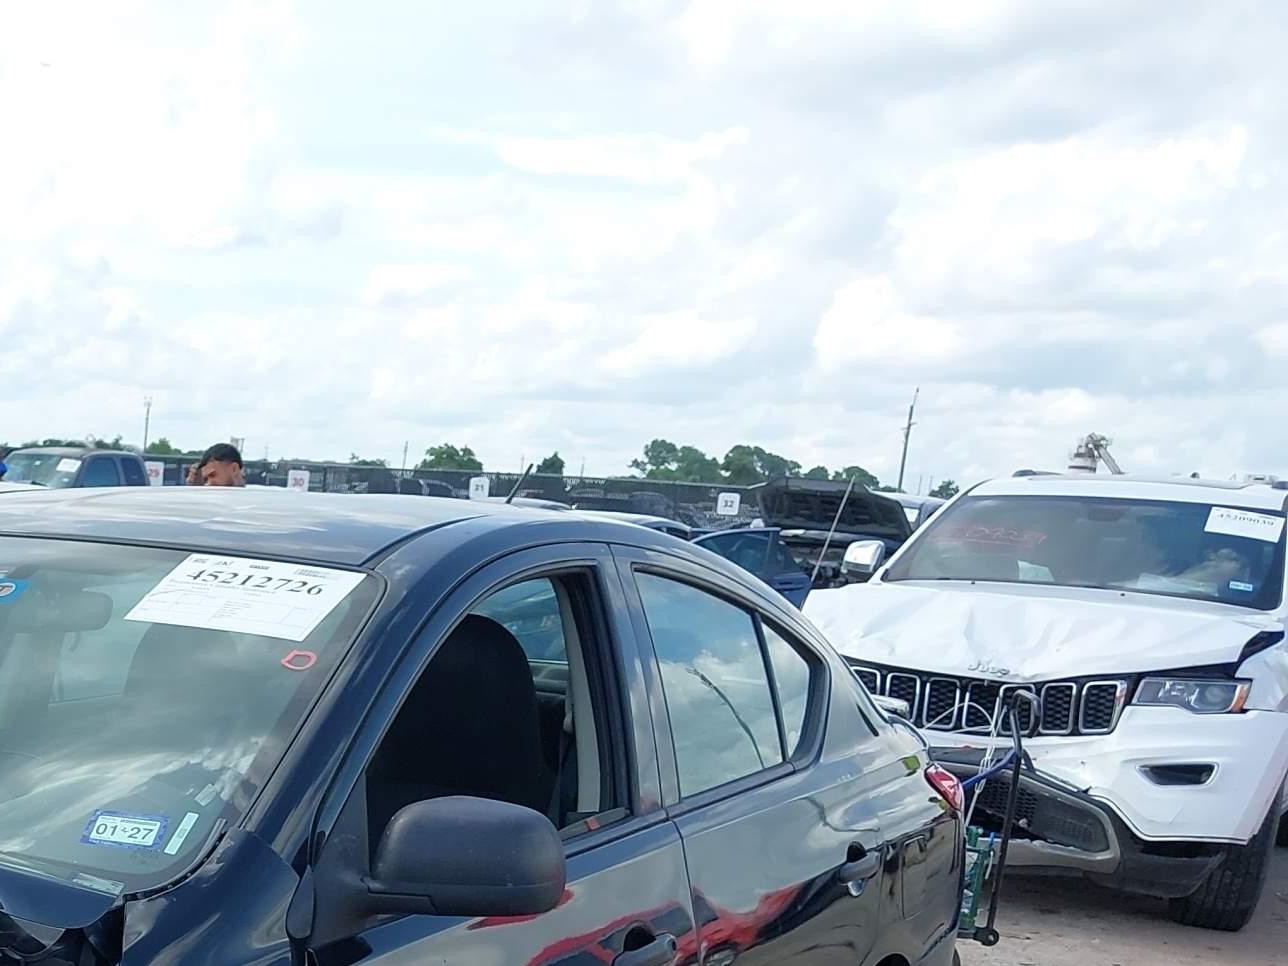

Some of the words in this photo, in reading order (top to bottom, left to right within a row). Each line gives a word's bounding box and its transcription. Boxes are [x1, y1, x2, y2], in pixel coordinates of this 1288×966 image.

[186, 568, 324, 597] 45212726
[95, 823, 118, 837] 01
[127, 826, 155, 840] 27
